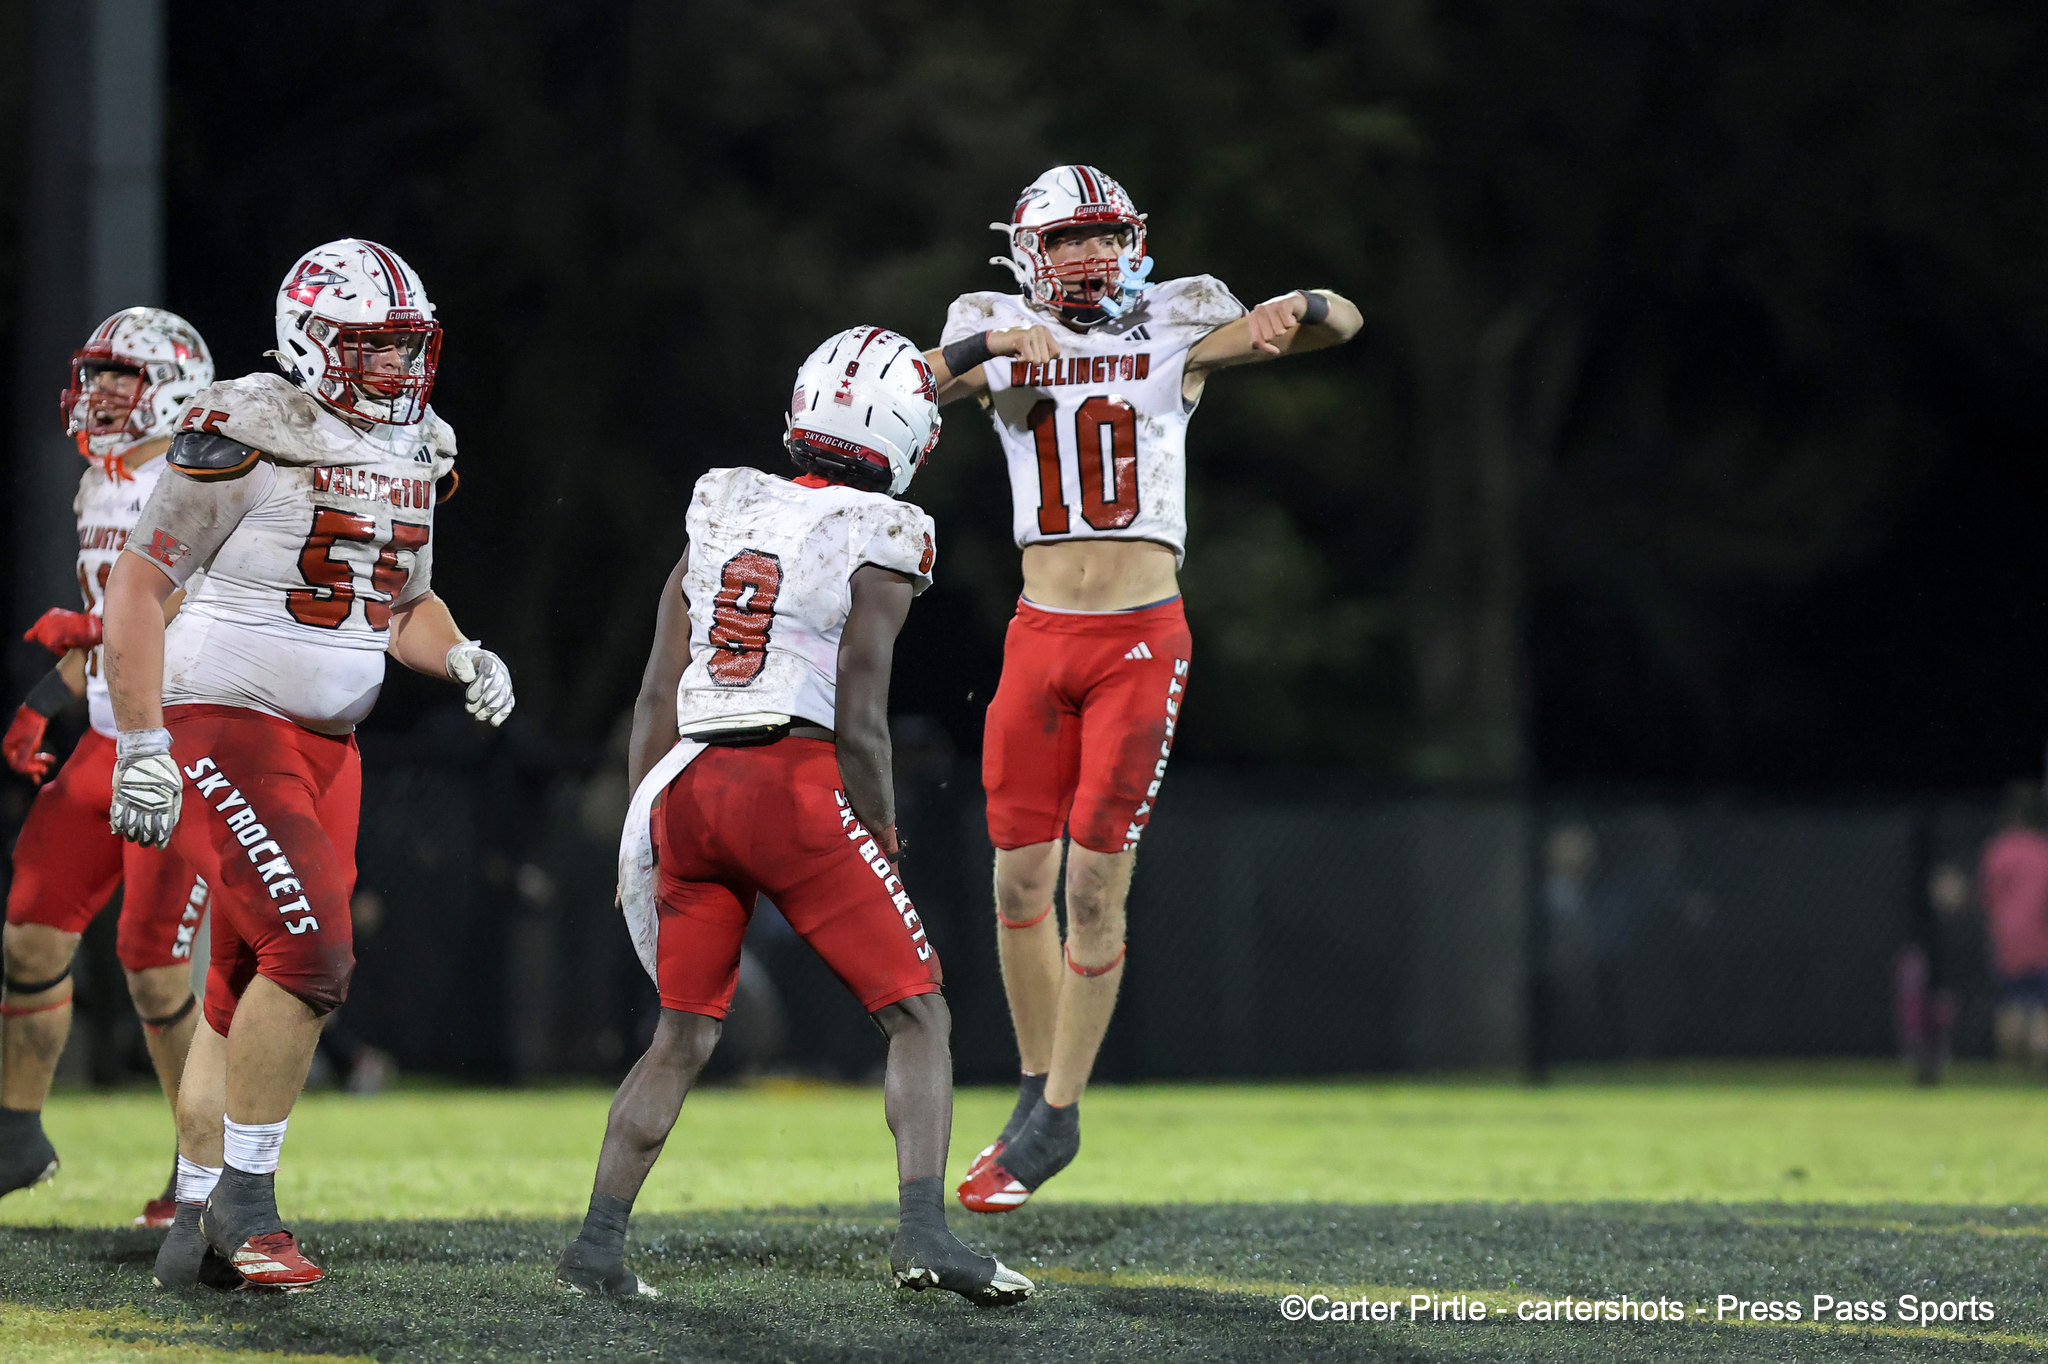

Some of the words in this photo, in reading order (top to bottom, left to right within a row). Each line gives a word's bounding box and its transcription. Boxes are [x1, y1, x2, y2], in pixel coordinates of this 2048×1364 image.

[845, 360, 860, 378] 8
[1011, 353, 1150, 387] WELLINGTON
[804, 431, 862, 455] SKYROCKETS
[1027, 394, 1140, 535] 10
[286, 505, 431, 632] 55
[918, 531, 934, 575] 8
[707, 548, 784, 687] 8
[184, 756, 320, 936] SKYROCKETS
